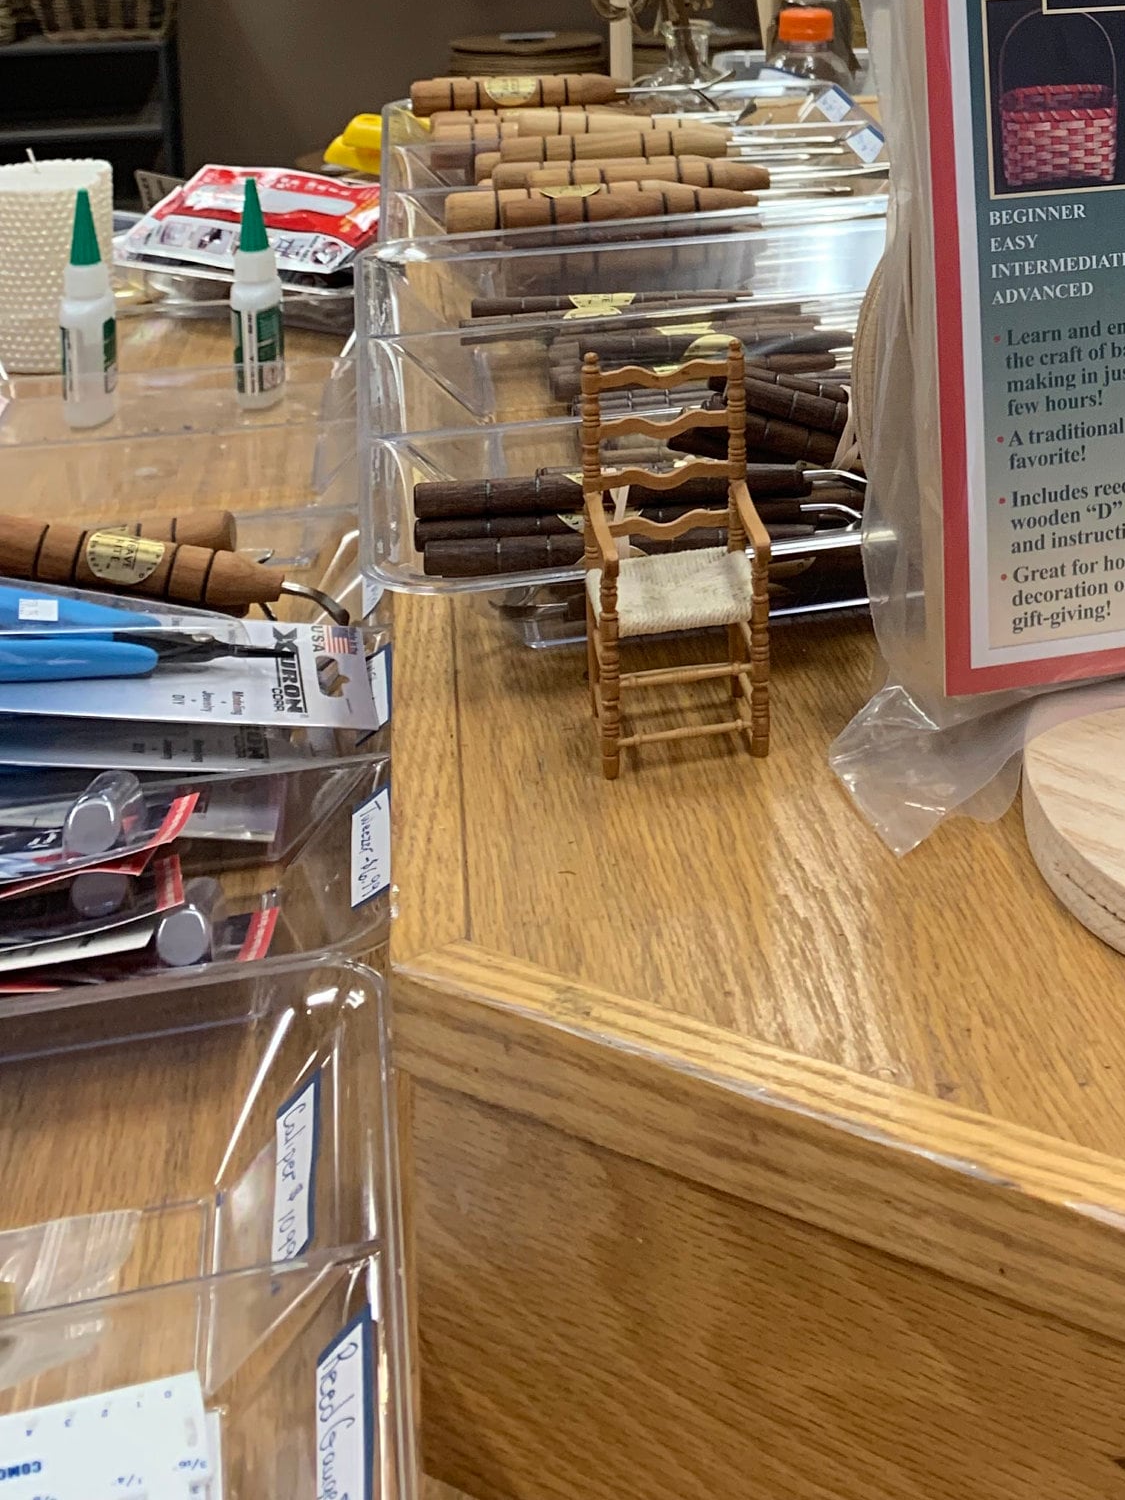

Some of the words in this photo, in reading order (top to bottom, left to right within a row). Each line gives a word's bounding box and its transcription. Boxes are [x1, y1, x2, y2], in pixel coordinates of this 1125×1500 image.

[989, 203, 1087, 226] BEGINNER
[990, 234, 1039, 252] EASY
[991, 281, 1094, 305] ADVANCED
[1007, 328, 1062, 347] Learn
[1068, 320, 1101, 339] and
[1006, 352, 1035, 370] the
[1040, 346, 1083, 366] craft
[1088, 343, 1107, 361] of
[1007, 370, 1077, 394] making
[1081, 368, 1099, 385] in
[1007, 398, 1040, 417] few
[1045, 389, 1104, 412] hours!
[1008, 430, 1025, 448] A
[1028, 417, 1125, 444] traditional
[1009, 445, 1087, 471] favorite!
[1011, 484, 1089, 509] Includes
[1010, 507, 1081, 531] wooden
[1011, 533, 1046, 554] and
[1012, 561, 1067, 584] Great
[1072, 558, 1099, 577] for
[1012, 579, 1109, 607] decoration
[1012, 600, 1112, 634] gift-giving!
[311, 625, 325, 653] USA
[277, 1103, 307, 1182] Caliper
[319, 1342, 359, 1422] Reed
